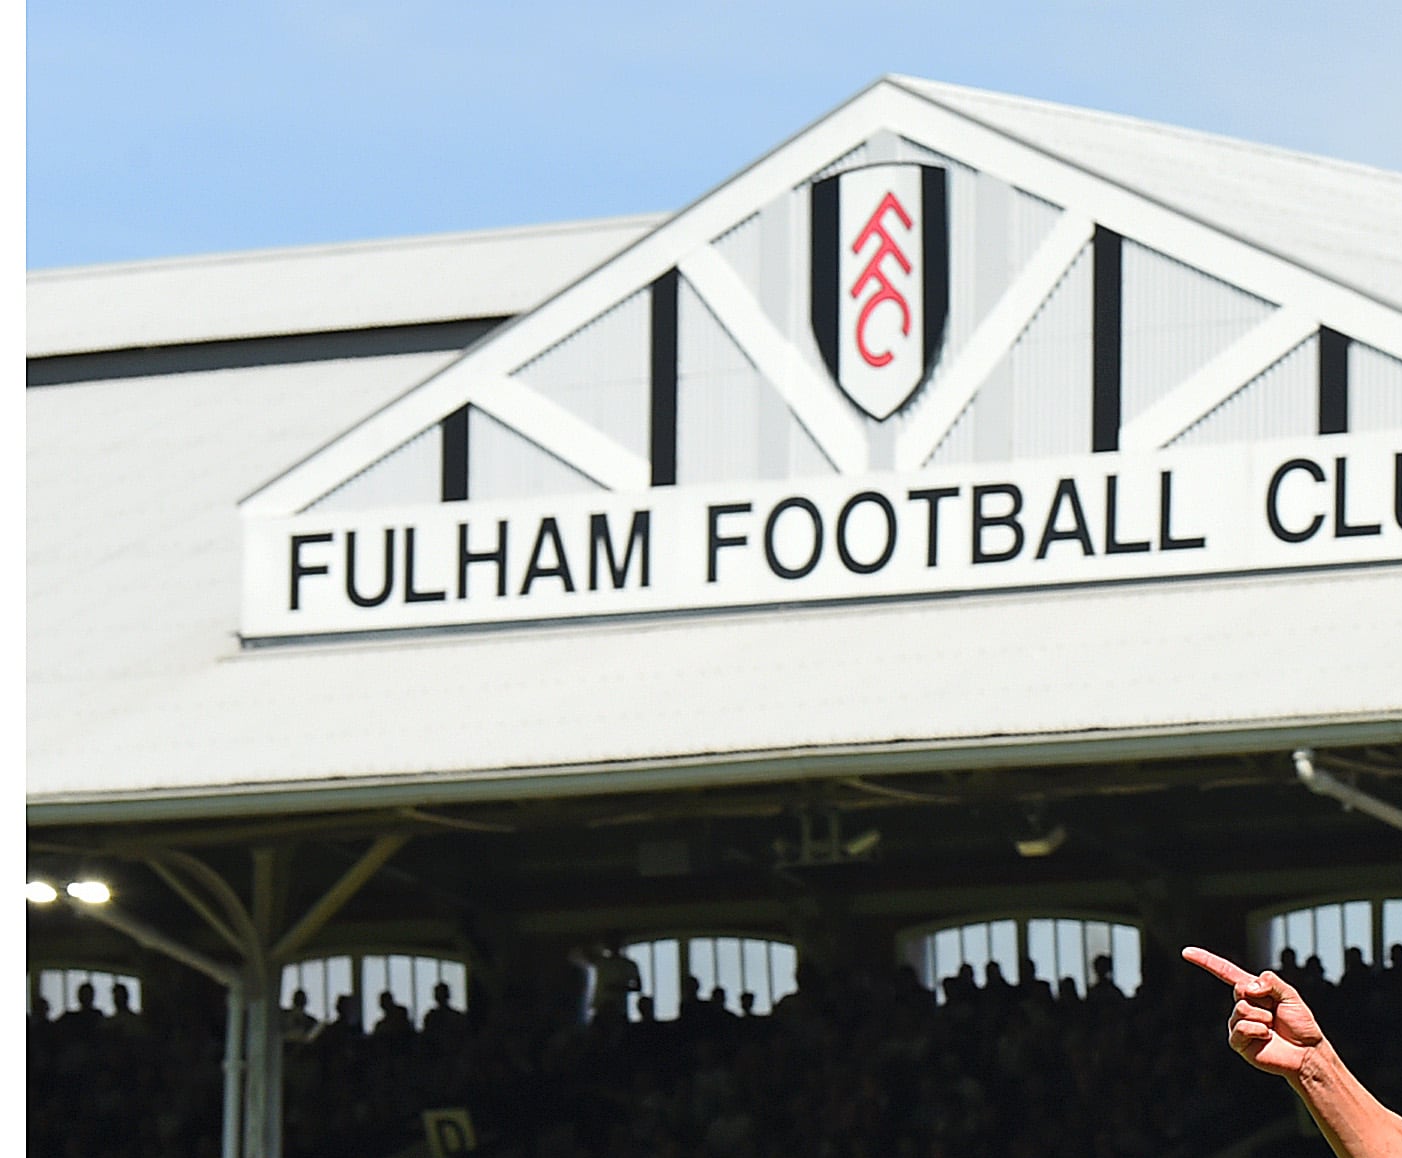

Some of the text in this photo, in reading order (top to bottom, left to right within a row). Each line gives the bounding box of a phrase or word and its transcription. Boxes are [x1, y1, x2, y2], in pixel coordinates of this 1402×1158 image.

[851, 191, 914, 368] FFC
[288, 510, 652, 611] FULHAM
[705, 470, 1207, 584] FOOTBALL
